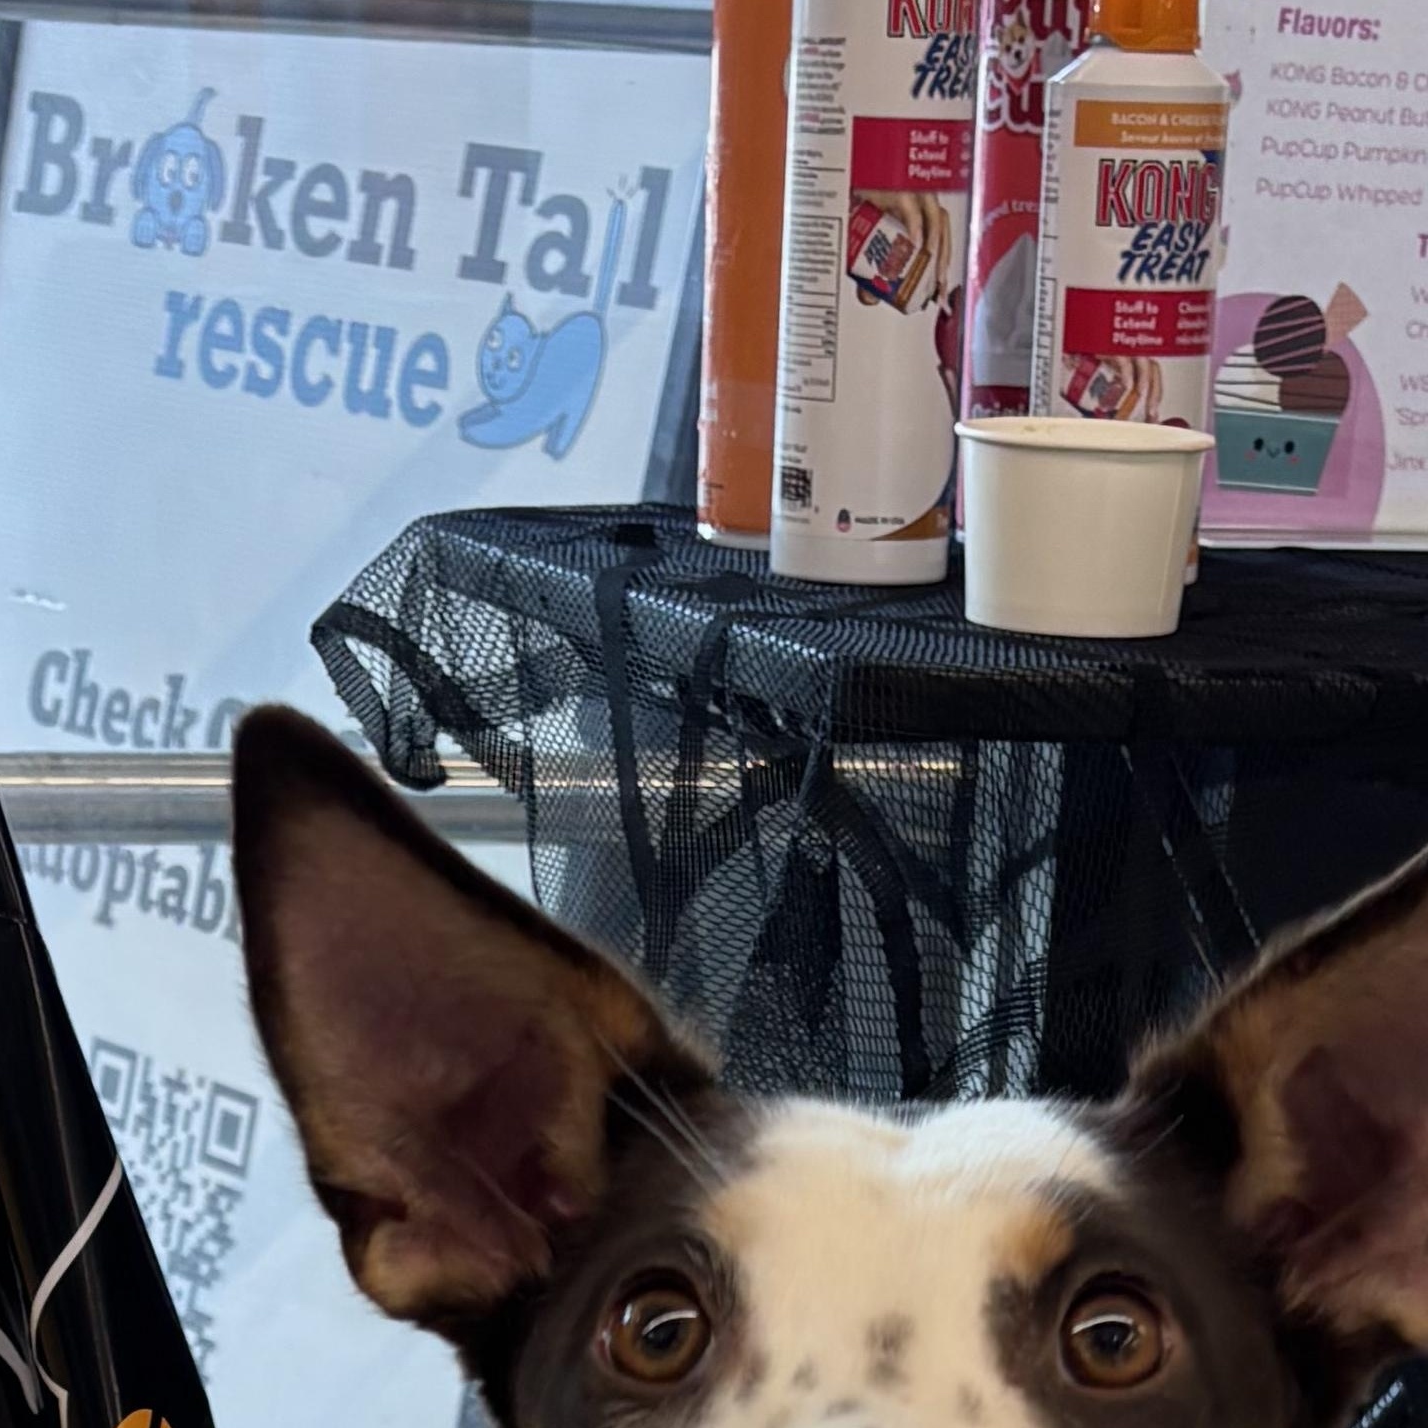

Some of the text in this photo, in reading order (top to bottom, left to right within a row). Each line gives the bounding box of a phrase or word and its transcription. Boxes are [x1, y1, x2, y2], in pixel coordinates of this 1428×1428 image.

[887, 0, 976, 39] KON
[1277, 7, 1380, 41] Flavors:
[924, 33, 975, 67] EAS
[1271, 63, 1326, 84] KONG
[1330, 66, 1391, 88] Bacon
[1267, 99, 1321, 120] KONG
[1326, 102, 1396, 126] Peanut
[1342, 141, 1428, 165] Pumpkin
[1095, 157, 1220, 227] KONG
[1337, 183, 1424, 206] Whipped
[1130, 222, 1210, 252] EASY
[1117, 250, 1210, 283] TREAT
[154, 290, 451, 428] rescue
[28, 648, 202, 749] Check
